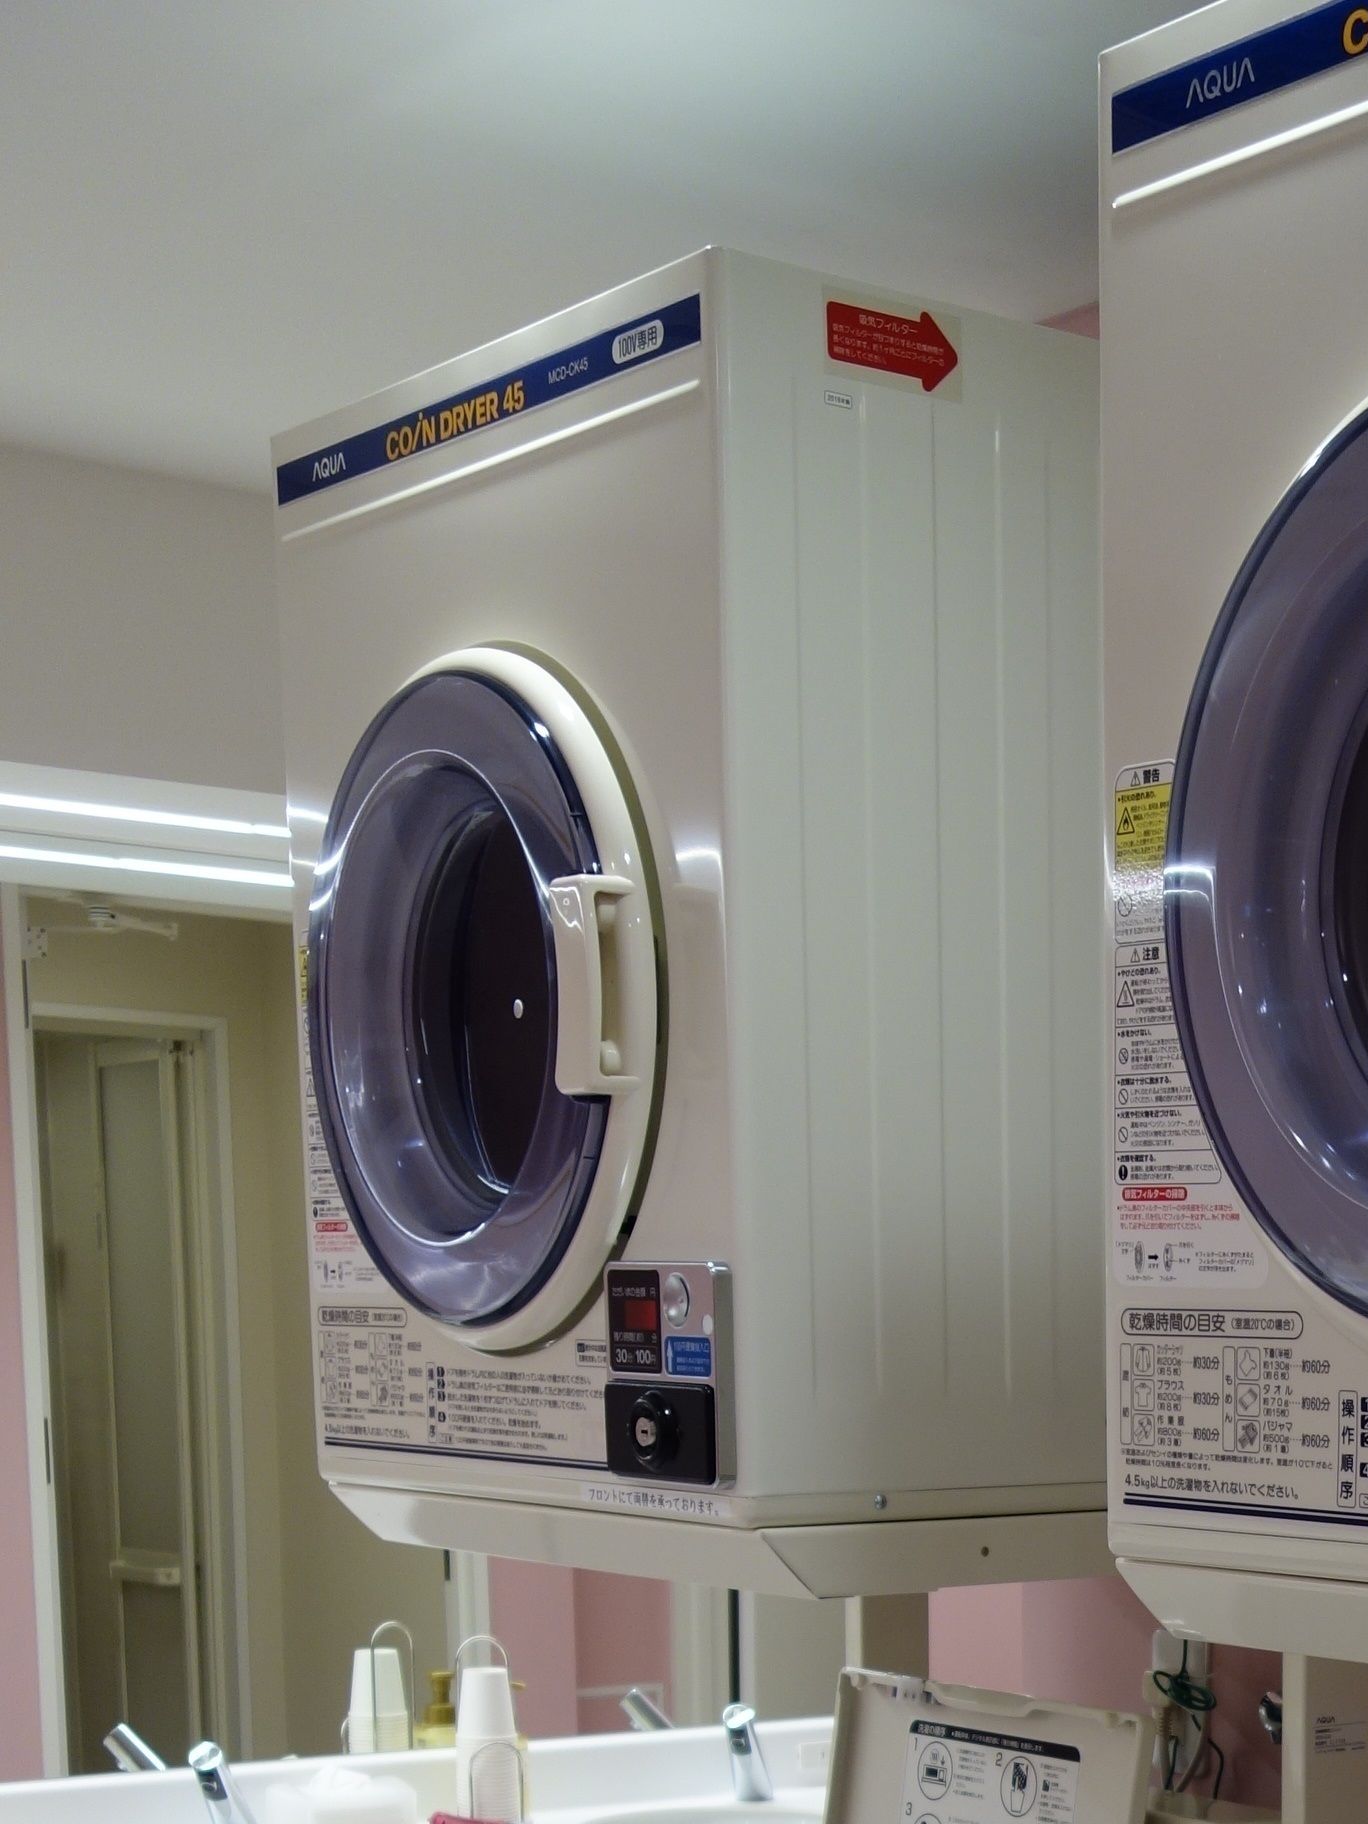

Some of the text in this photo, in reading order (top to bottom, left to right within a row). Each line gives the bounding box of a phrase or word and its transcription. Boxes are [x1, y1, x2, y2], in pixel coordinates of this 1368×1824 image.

[1186, 57, 1255, 108] AQUA
[312, 452, 346, 481] AQUA
[440, 392, 498, 441] DRYER
[503, 380, 524, 413] 45
[548, 357, 588, 384] MCD-CK45
[617, 326, 657, 359] 100V専用
[1143, 769, 1160, 783] 警告
[1143, 947, 1159, 960] 注意
[1129, 1312, 1226, 1332] 乾燥時間の目安
[1340, 1399, 1354, 1499] 操作順序
